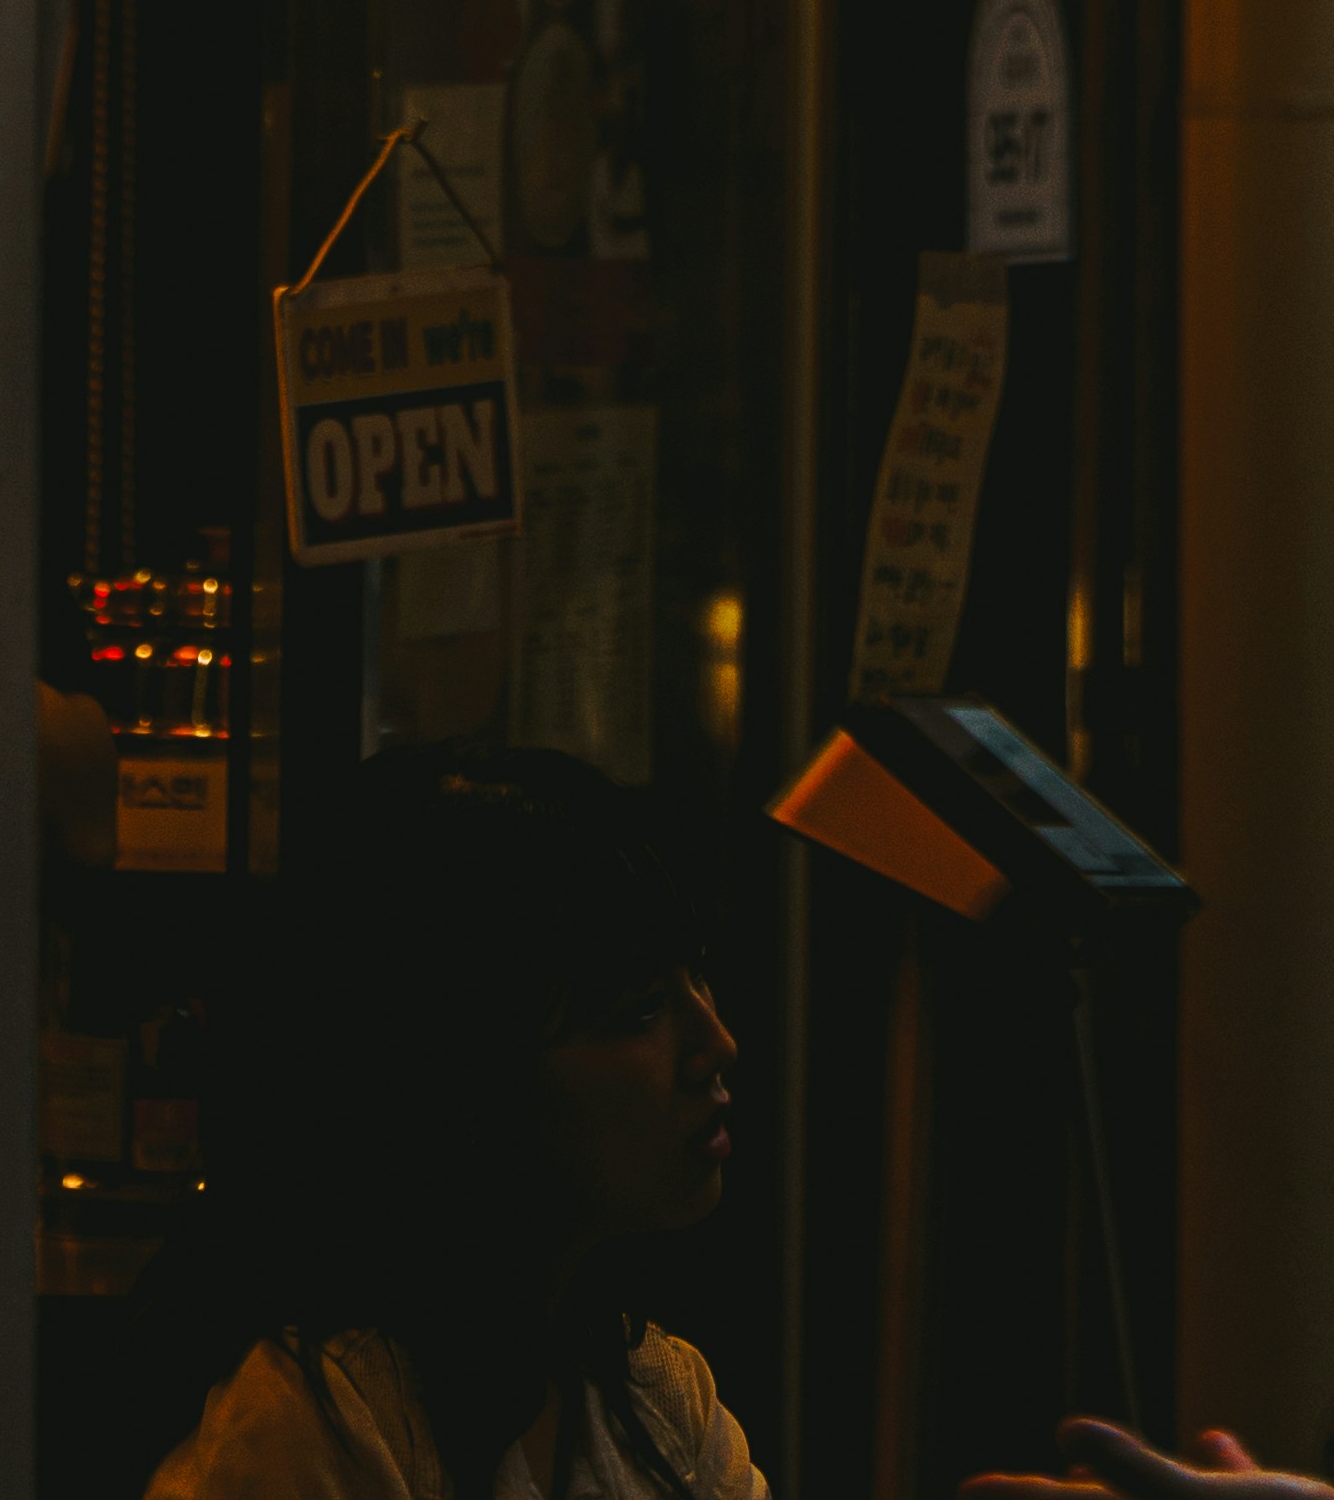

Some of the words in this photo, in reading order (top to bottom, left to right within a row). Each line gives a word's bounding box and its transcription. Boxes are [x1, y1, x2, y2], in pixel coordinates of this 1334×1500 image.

[301, 321, 375, 381] COME
[380, 317, 408, 370] IN
[306, 397, 500, 523] OPEN
